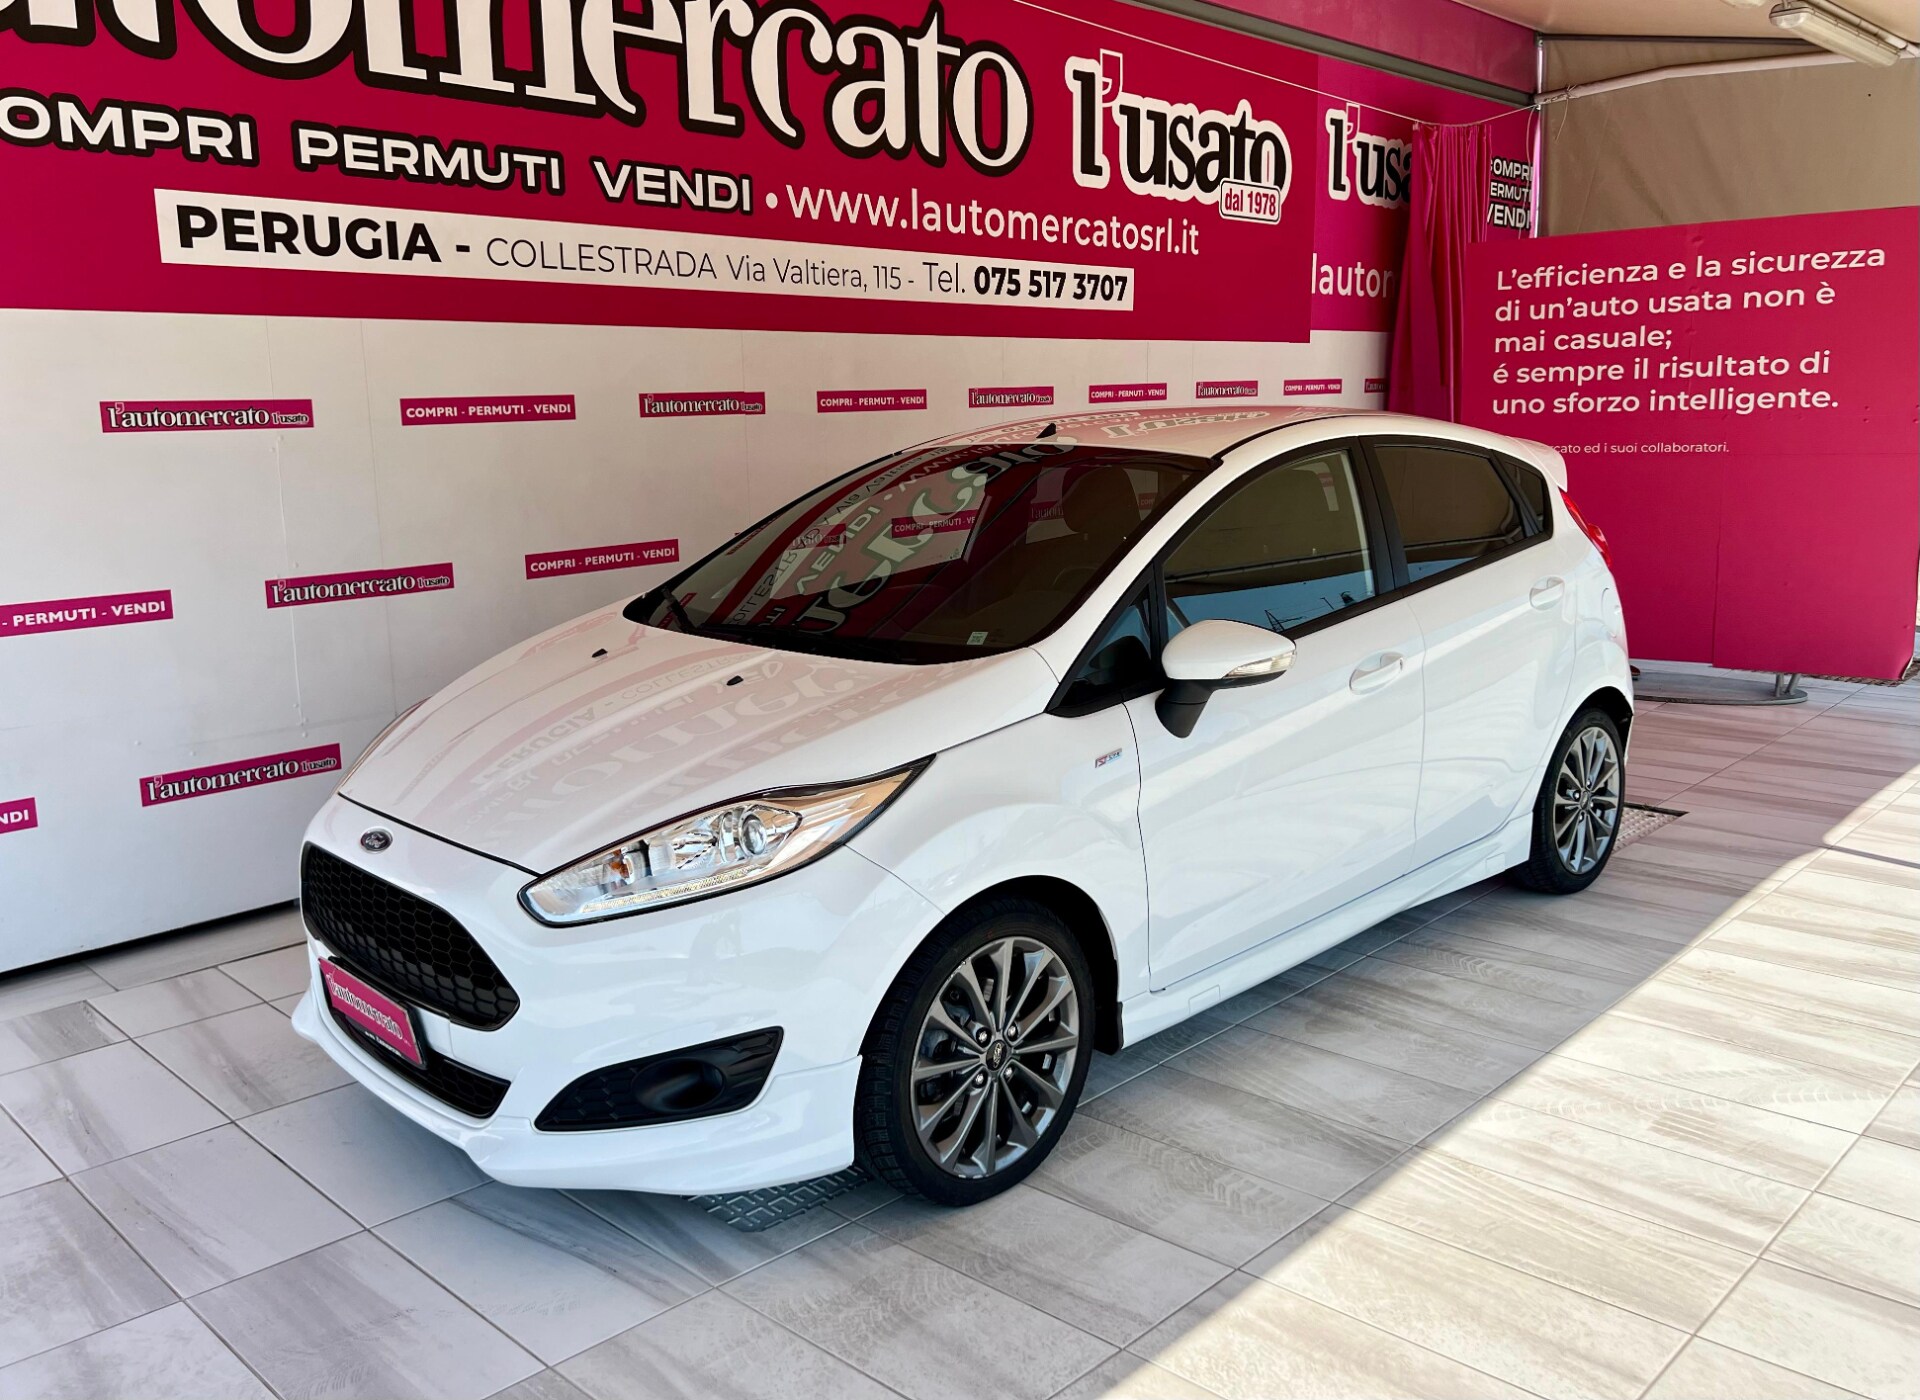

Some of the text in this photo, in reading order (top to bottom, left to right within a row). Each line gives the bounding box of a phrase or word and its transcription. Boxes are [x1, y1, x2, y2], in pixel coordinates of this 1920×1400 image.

[1067, 48, 1290, 200] l'usato
[0, 95, 752, 212] OMPRI PERMUTI VENDI
[1328, 103, 1412, 204] l'us
[1490, 158, 1534, 181] OMPRI
[1224, 188, 1277, 217] dal 1978
[1490, 181, 1533, 204] ERMUTI
[786, 183, 1200, 256] www.lautomercatosrl.it
[175, 204, 442, 263] PERUGIA
[486, 237, 718, 279] COLLESTRADA
[726, 254, 766, 282] Via
[772, 257, 868, 292] Valtiera,
[873, 264, 902, 290] 115
[922, 261, 966, 294] Tel.
[973, 265, 1021, 297] 075
[1027, 269, 1067, 299] 517
[1072, 272, 1128, 302] 3707
[1311, 252, 1395, 298] lauto
[1496, 247, 1887, 291] L'efficienza e la sicurezza
[1494, 282, 1836, 322] di un'auto usata non è
[1494, 325, 1672, 353] mai casuale;
[1492, 350, 1831, 387] é sempre il risultato di
[643, 393, 740, 414] l'automercato
[820, 397, 853, 407] COMPRI
[858, 396, 895, 406] PERMUTI
[900, 396, 924, 405] VENDI
[971, 388, 1036, 405] l'automercato
[1091, 390, 1114, 399] COMPRI
[1147, 388, 1166, 397] VENDI
[1492, 386, 1839, 416] uno sforzo intelligente.
[107, 402, 310, 428] l'automercato l'usato
[405, 406, 458, 418] COMPRI
[468, 404, 525, 416] PERMUTI
[533, 403, 571, 414] VENDI
[1551, 443, 1581, 454] cato
[1583, 442, 1600, 453] ed
[1610, 442, 1638, 454] suoi
[1640, 441, 1730, 454] collaboratori.
[530, 558, 576, 572] COMPRI
[584, 551, 635, 566] PERMUTI
[642, 547, 675, 560] VENDI
[13, 606, 97, 628] PERMUTI
[110, 600, 166, 618] VENDI
[147, 759, 299, 801] l'automercato
[0, 809, 29, 825] NDI
